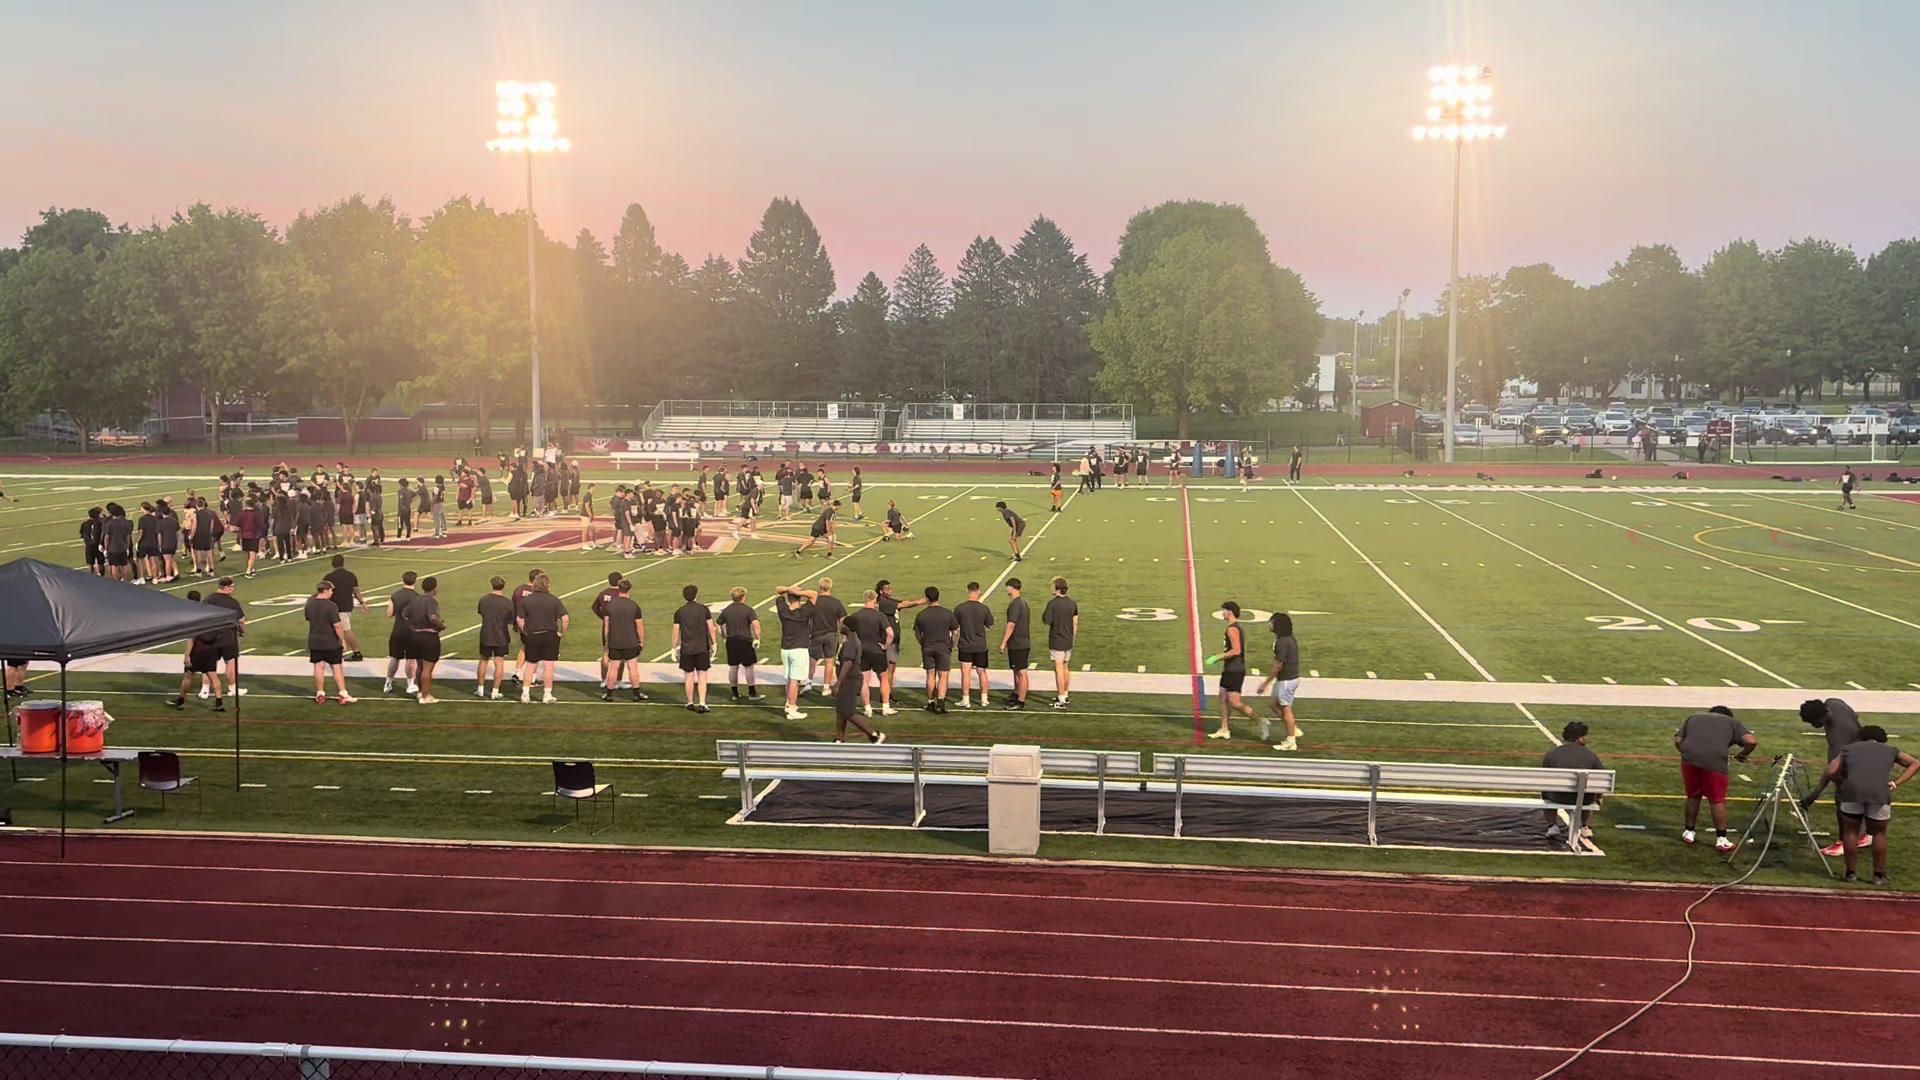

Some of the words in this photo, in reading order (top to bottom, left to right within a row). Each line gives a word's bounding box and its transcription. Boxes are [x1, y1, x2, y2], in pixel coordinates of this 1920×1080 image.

[627, 440, 690, 452] HOME
[701, 440, 729, 452] OF
[797, 440, 877, 454] WALSH
